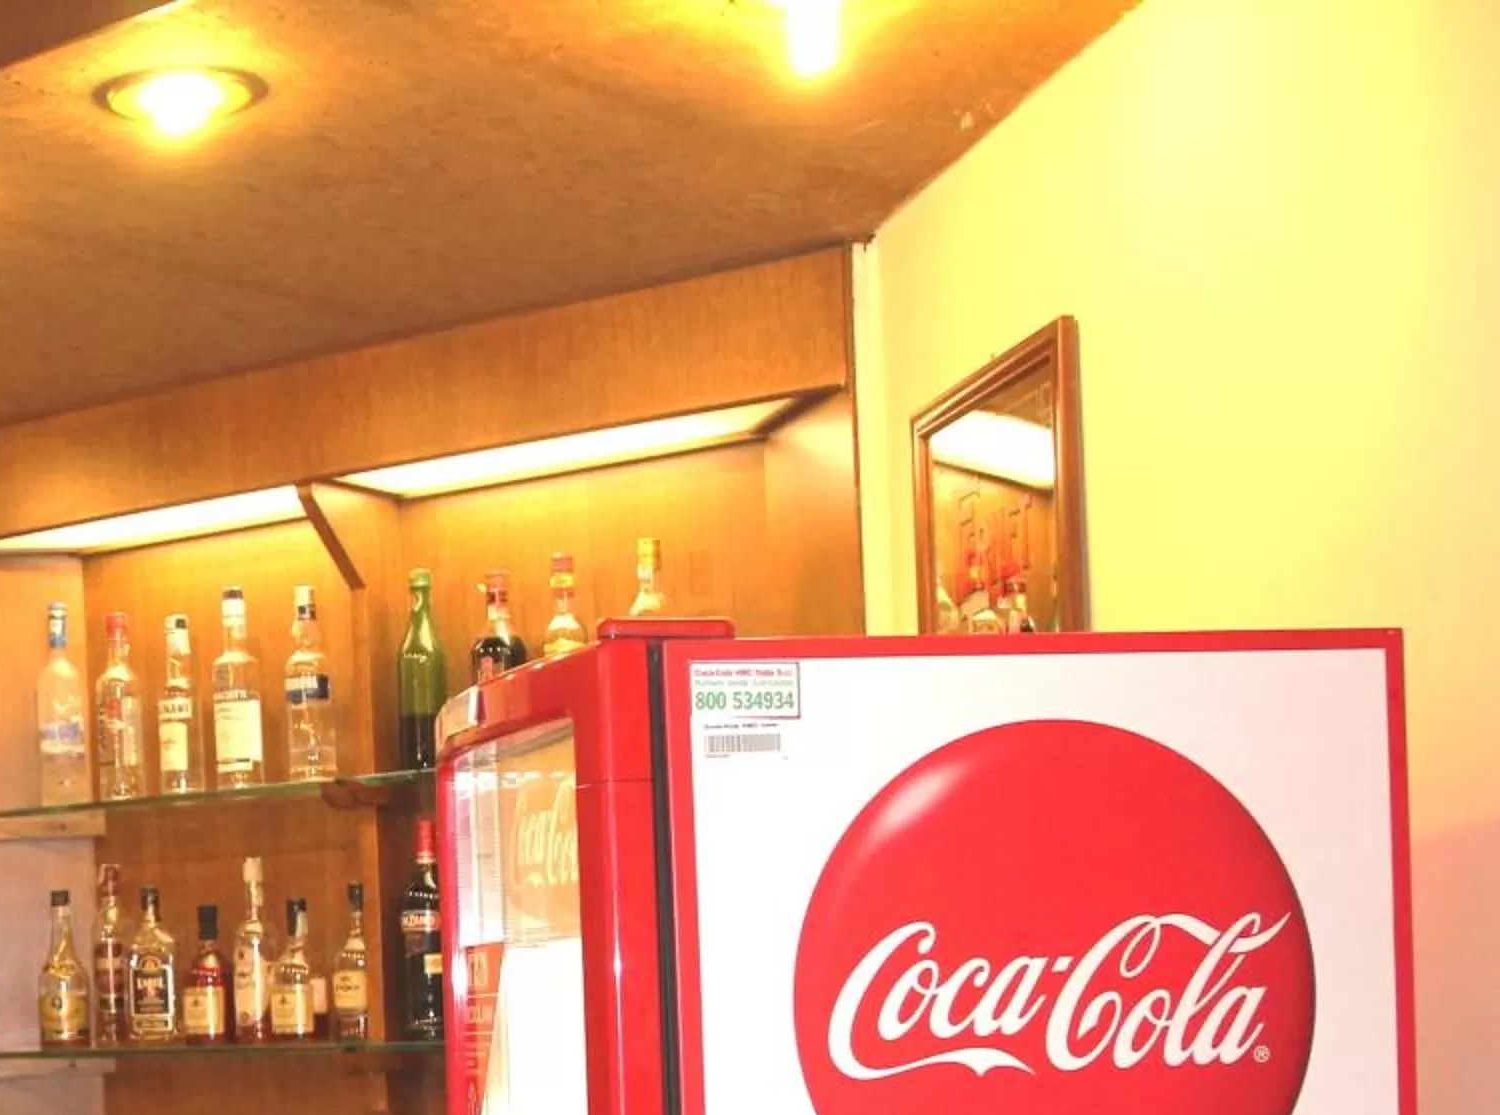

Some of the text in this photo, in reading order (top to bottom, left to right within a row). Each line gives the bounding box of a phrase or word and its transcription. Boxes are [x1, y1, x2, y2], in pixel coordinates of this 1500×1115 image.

[695, 690, 795, 711] 800 534934
[827, 911, 1290, 1081] Coca-Cola
